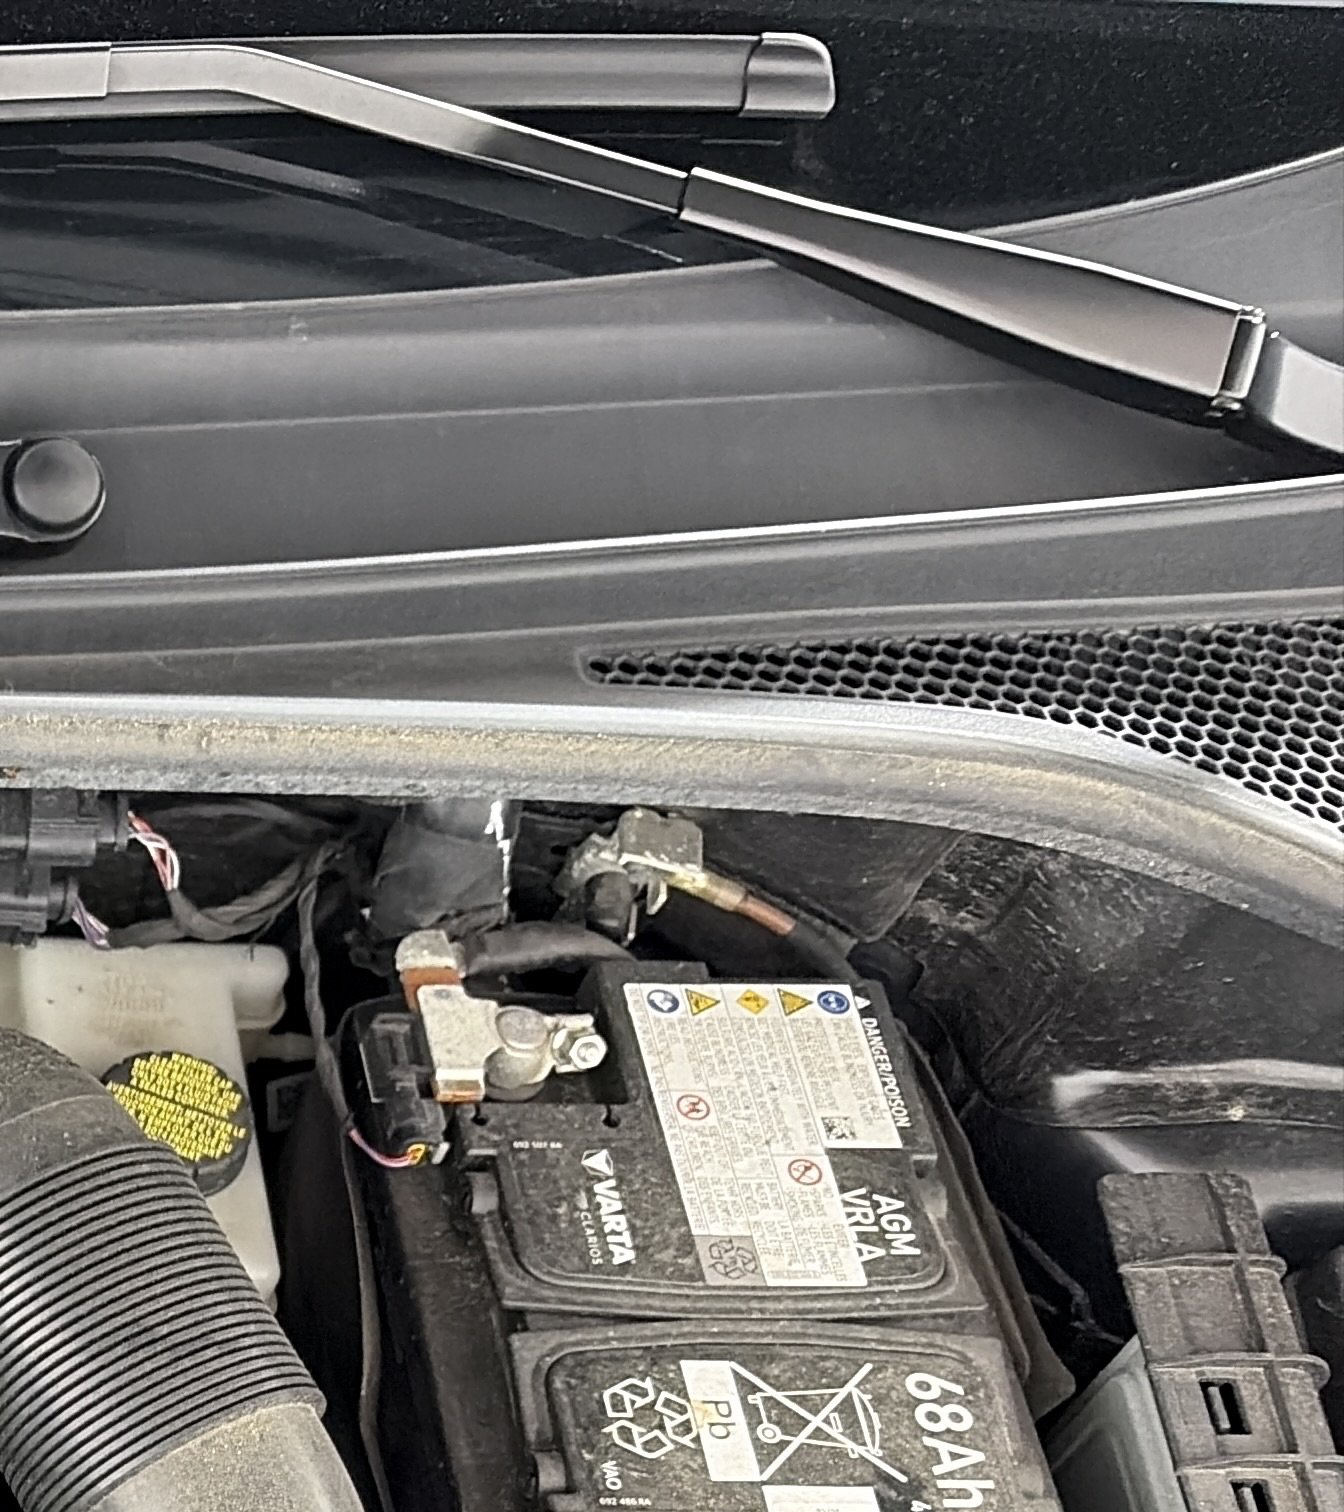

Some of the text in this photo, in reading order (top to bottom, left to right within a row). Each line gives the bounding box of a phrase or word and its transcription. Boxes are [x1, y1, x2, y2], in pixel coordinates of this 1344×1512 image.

[213, 1075, 233, 1091] CAP
[860, 1017, 912, 1128] DANGER/POISON
[580, 1211, 602, 1265] CLARIOS
[593, 1178, 635, 1265] VARTA
[836, 1187, 889, 1262] VRLA
[869, 1193, 922, 1255] AGM
[701, 1399, 736, 1440] Pb
[900, 1372, 1002, 1508] 68Ah
